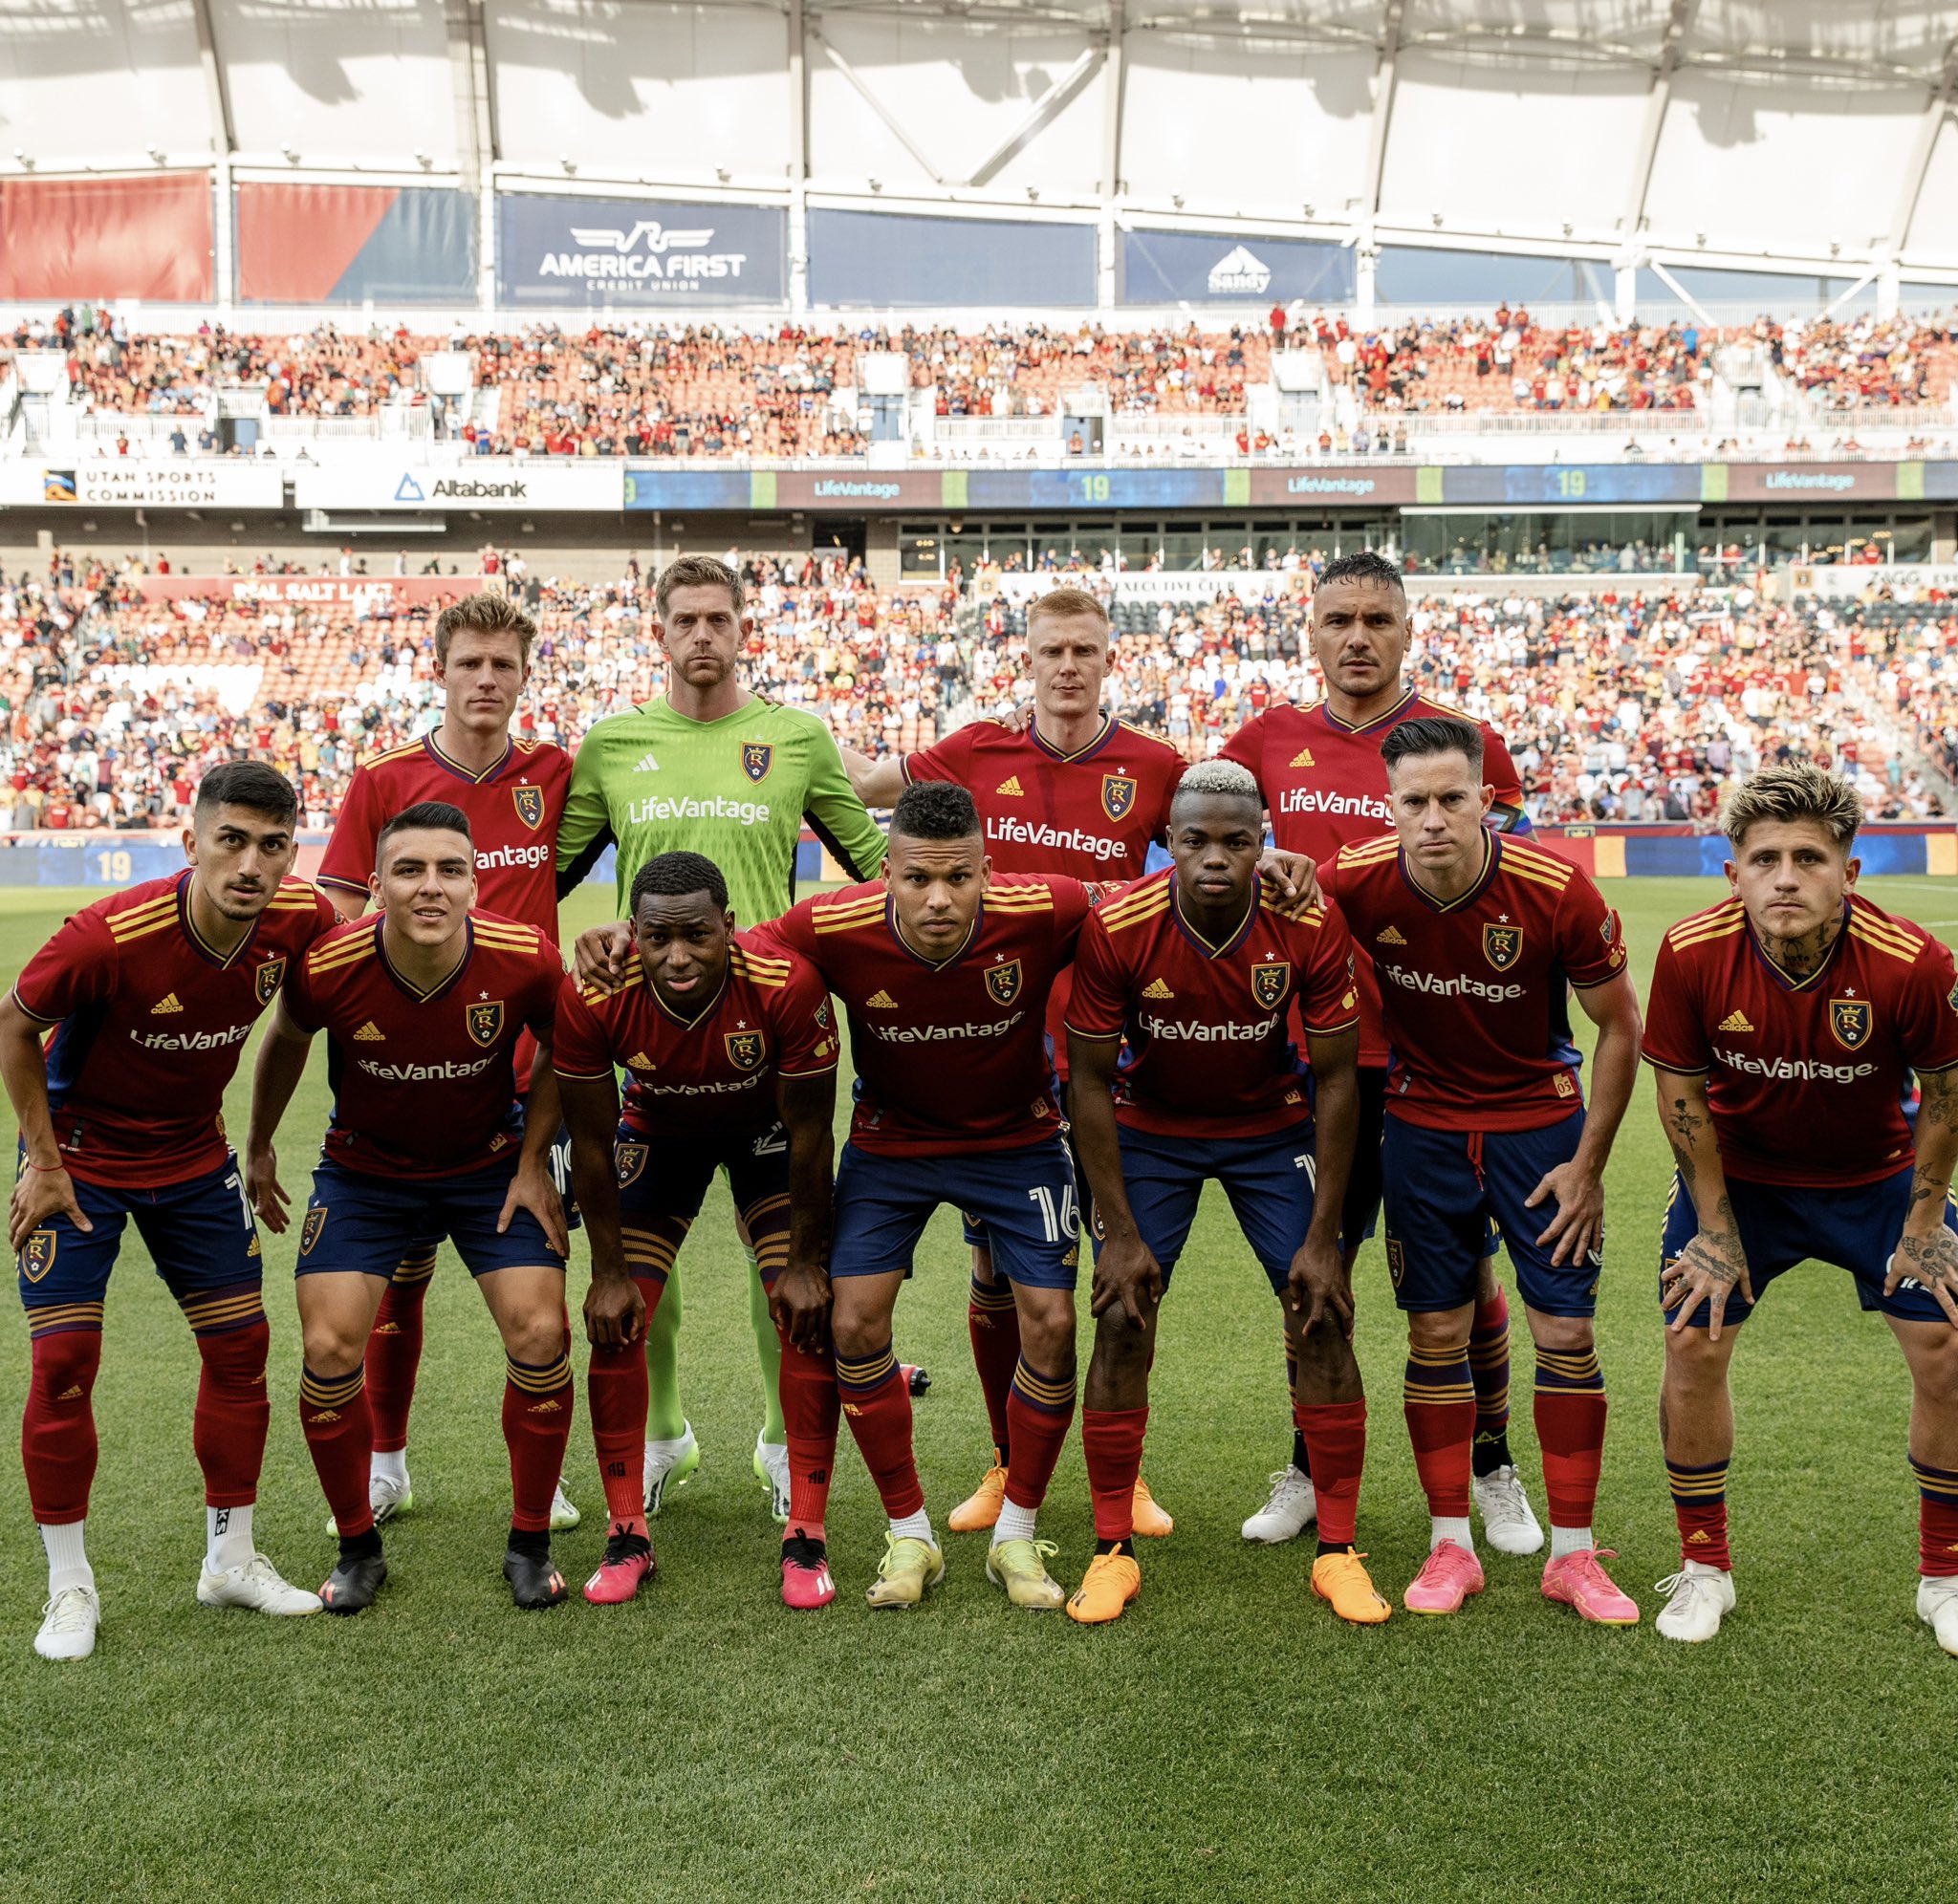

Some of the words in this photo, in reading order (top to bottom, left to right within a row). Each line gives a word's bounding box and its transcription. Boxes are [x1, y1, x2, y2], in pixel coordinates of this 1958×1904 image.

[538, 252, 664, 278] AMERICA
[666, 253, 747, 278] FIRST
[586, 279, 643, 292] CREDIT
[651, 279, 700, 292] UNION
[87, 471, 136, 483] UTAH
[146, 471, 217, 485] SPORTS
[1288, 476, 1375, 495] LifeVantage
[1556, 470, 1585, 497] 19
[1766, 471, 1855, 491] LifeVantage
[87, 488, 216, 502] COMMISSION
[432, 479, 527, 497] Altabank
[814, 480, 900, 499] LifeVantage
[1081, 475, 1110, 502] 19
[286, 582, 337, 601] SALT
[996, 787, 1024, 796] adidas
[629, 795, 770, 826] LifeVantage
[98, 850, 132, 882] 19
[1377, 936, 1407, 945] adidas
[865, 1000, 899, 1008] adidas
[1142, 990, 1175, 1000] adidas
[151, 1005, 184, 1015] adidas
[1718, 1024, 1754, 1032] adidas
[1557, 1081, 1572, 1093] 05
[1029, 1184, 1080, 1243] 16
